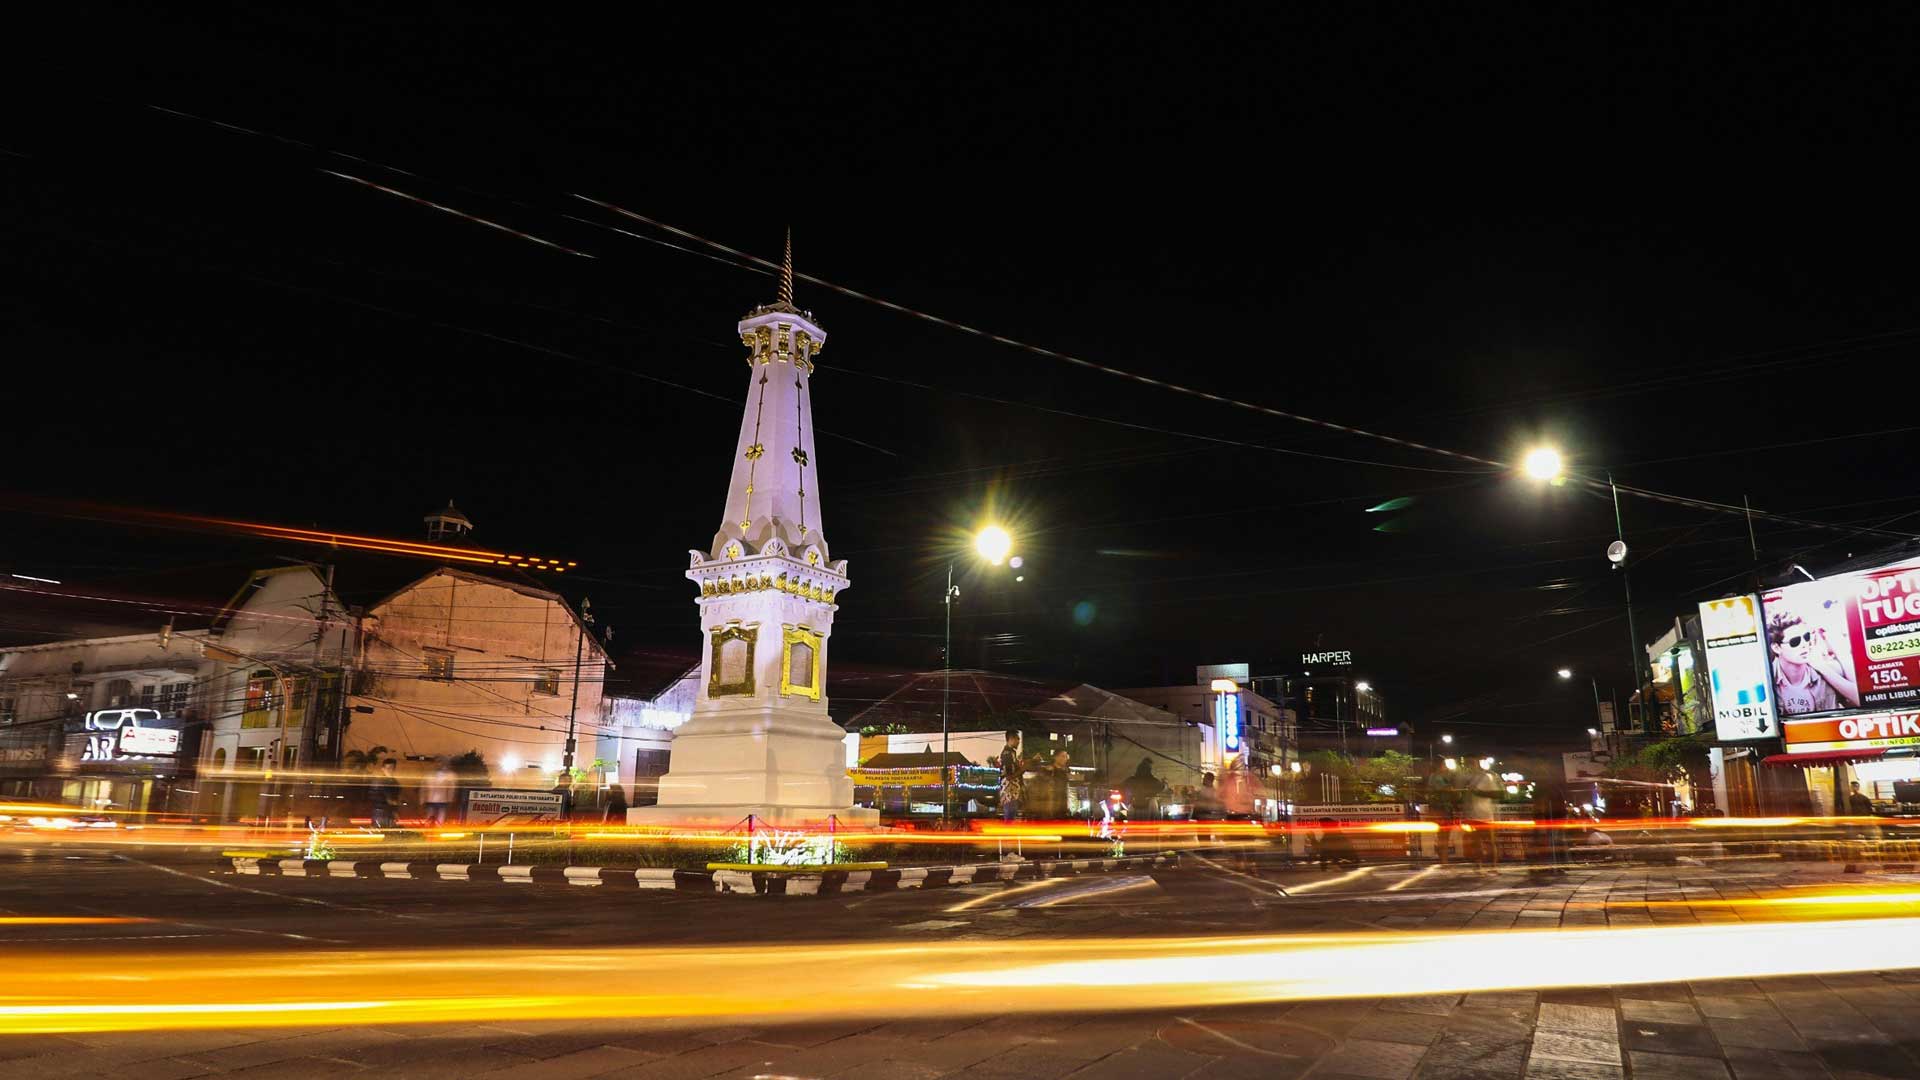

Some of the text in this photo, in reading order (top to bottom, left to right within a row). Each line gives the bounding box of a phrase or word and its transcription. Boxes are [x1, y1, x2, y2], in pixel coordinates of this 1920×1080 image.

[1303, 651, 1351, 663] HARPER
[1868, 661, 1904, 670] KACAMATA
[1870, 669, 1901, 684] 150
[1865, 693, 1887, 702] HARI
[1889, 689, 1917, 700] LIBUR
[1719, 707, 1767, 719] MOBIL
[1838, 714, 1920, 739] OPTIK
